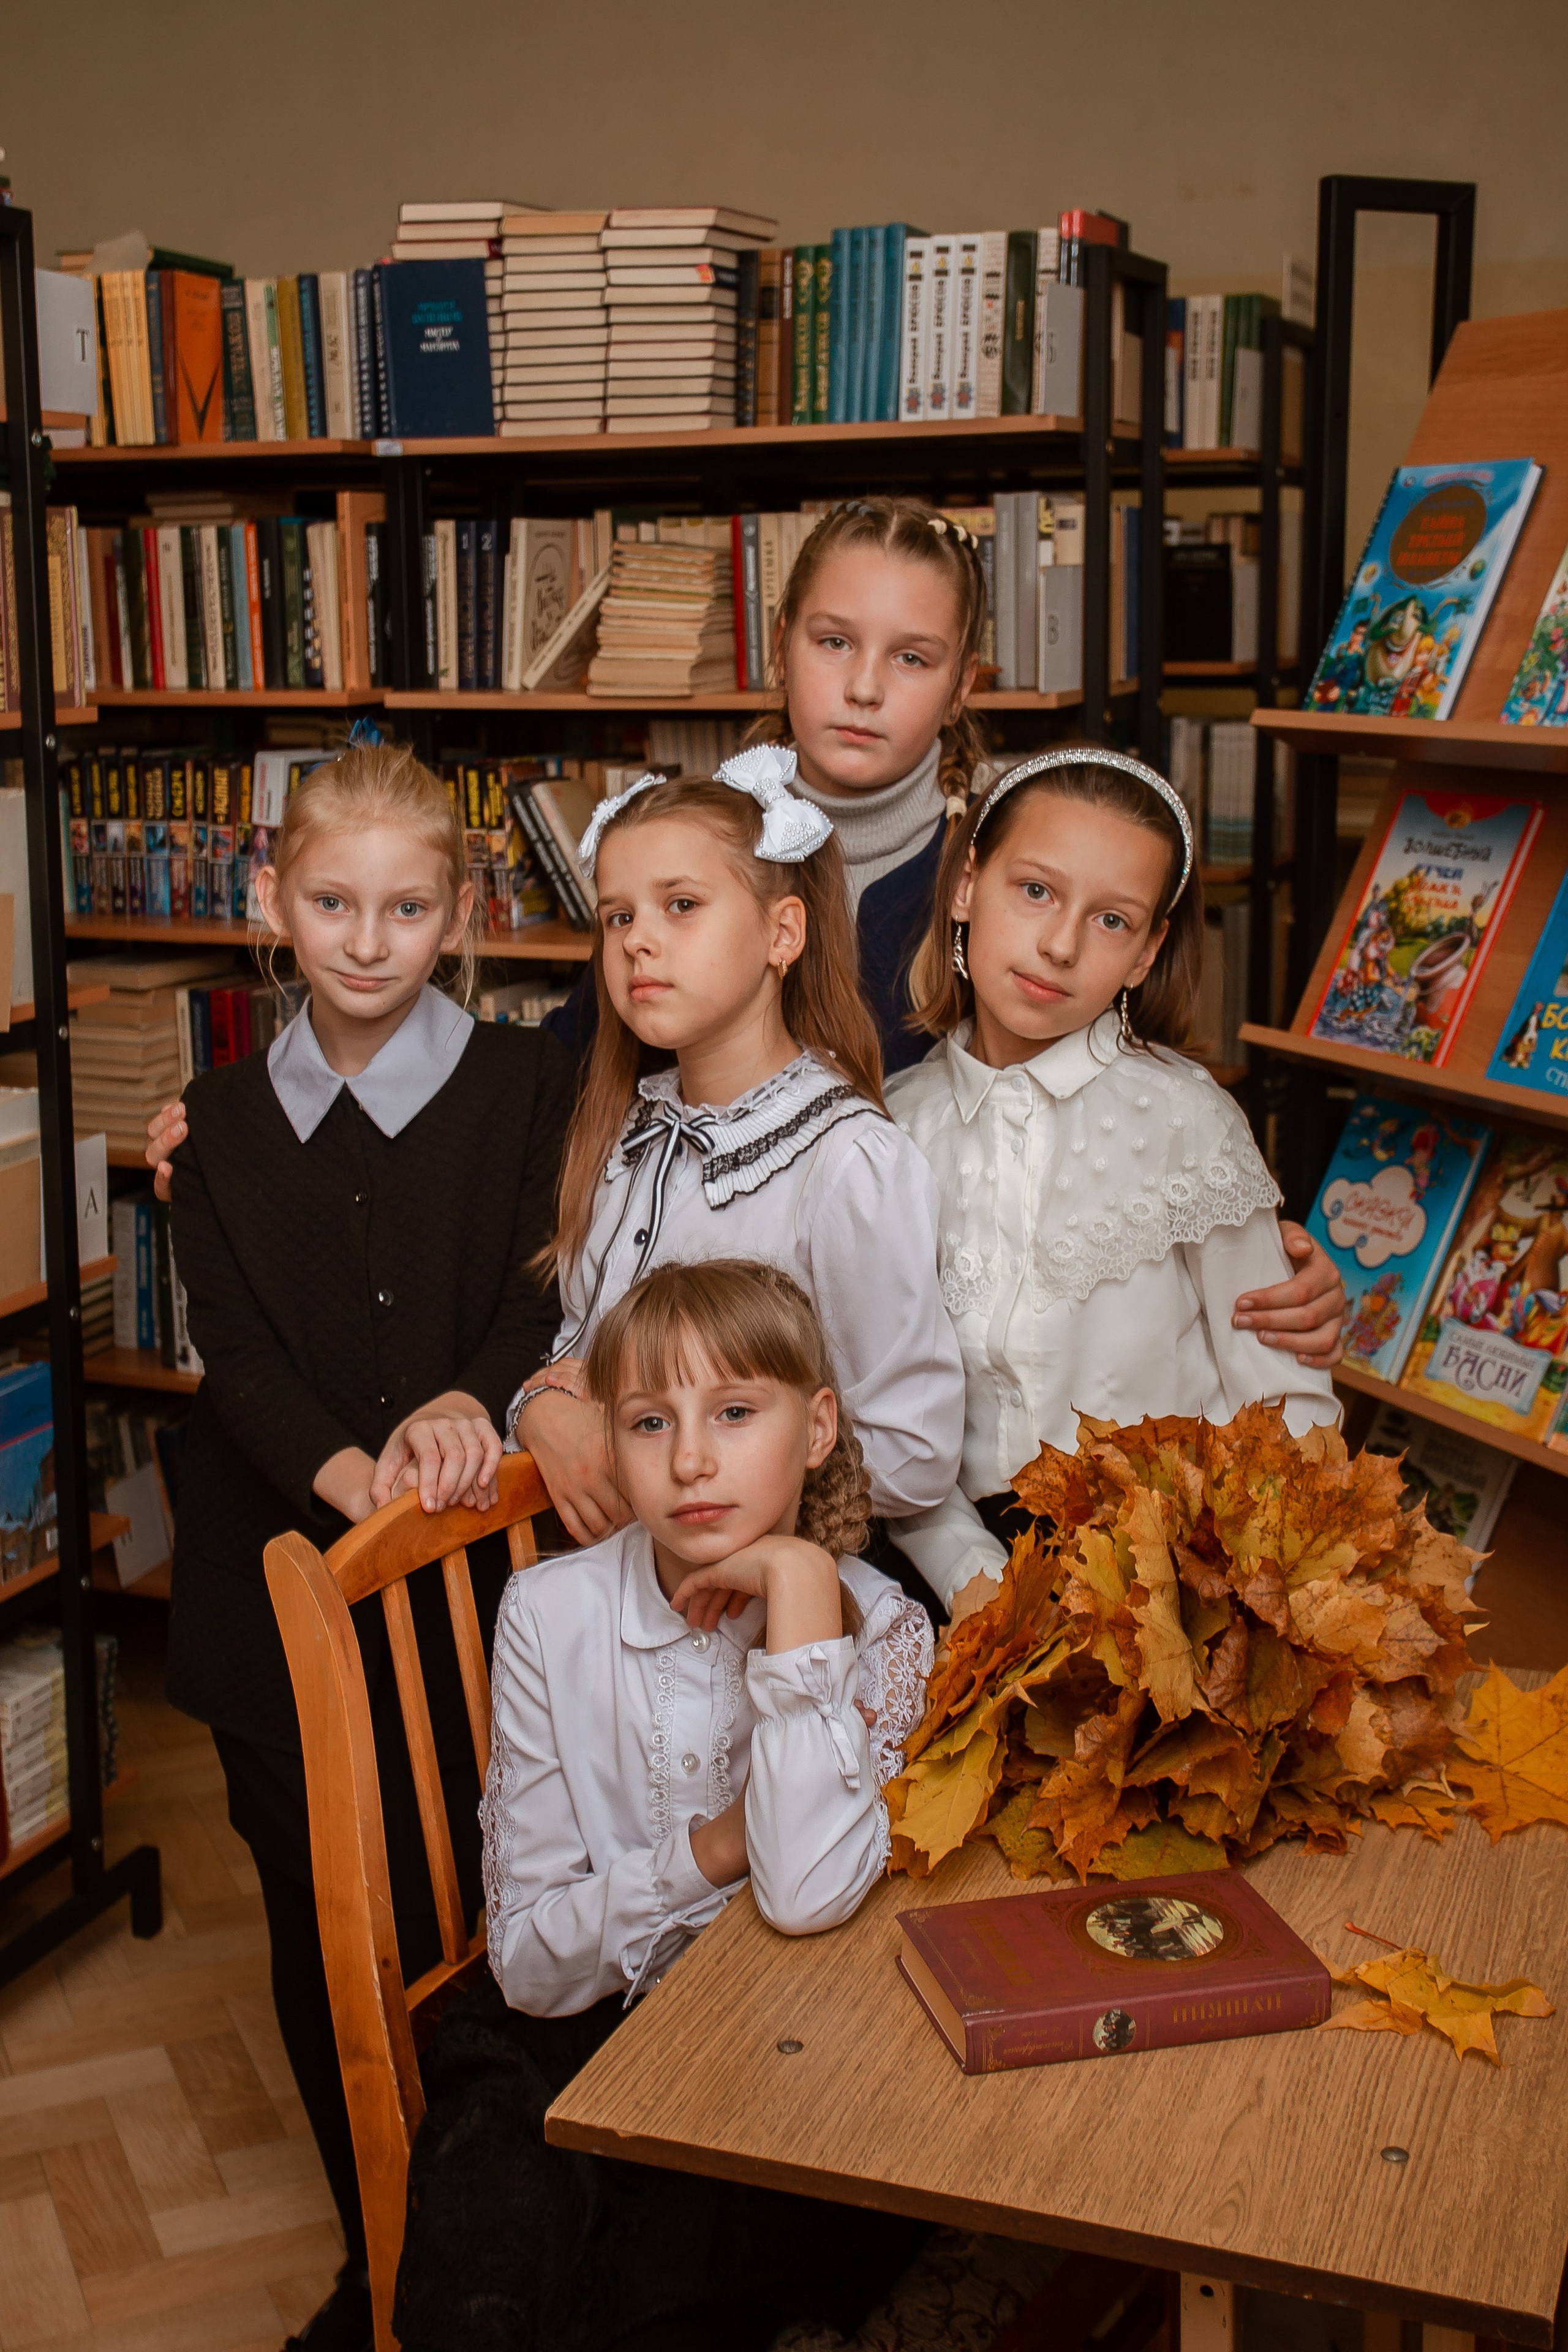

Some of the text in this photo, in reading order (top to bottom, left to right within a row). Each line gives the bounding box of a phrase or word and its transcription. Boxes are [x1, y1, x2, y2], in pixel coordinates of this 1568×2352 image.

[75, 328, 90, 363] Т
[462, 533, 469, 549] 1
[481, 533, 492, 551] 2
[84, 1186, 99, 1219] А
[1442, 1343, 1529, 1397] БАСНИ
[1172, 1991, 1283, 2024] ПУШКИН
